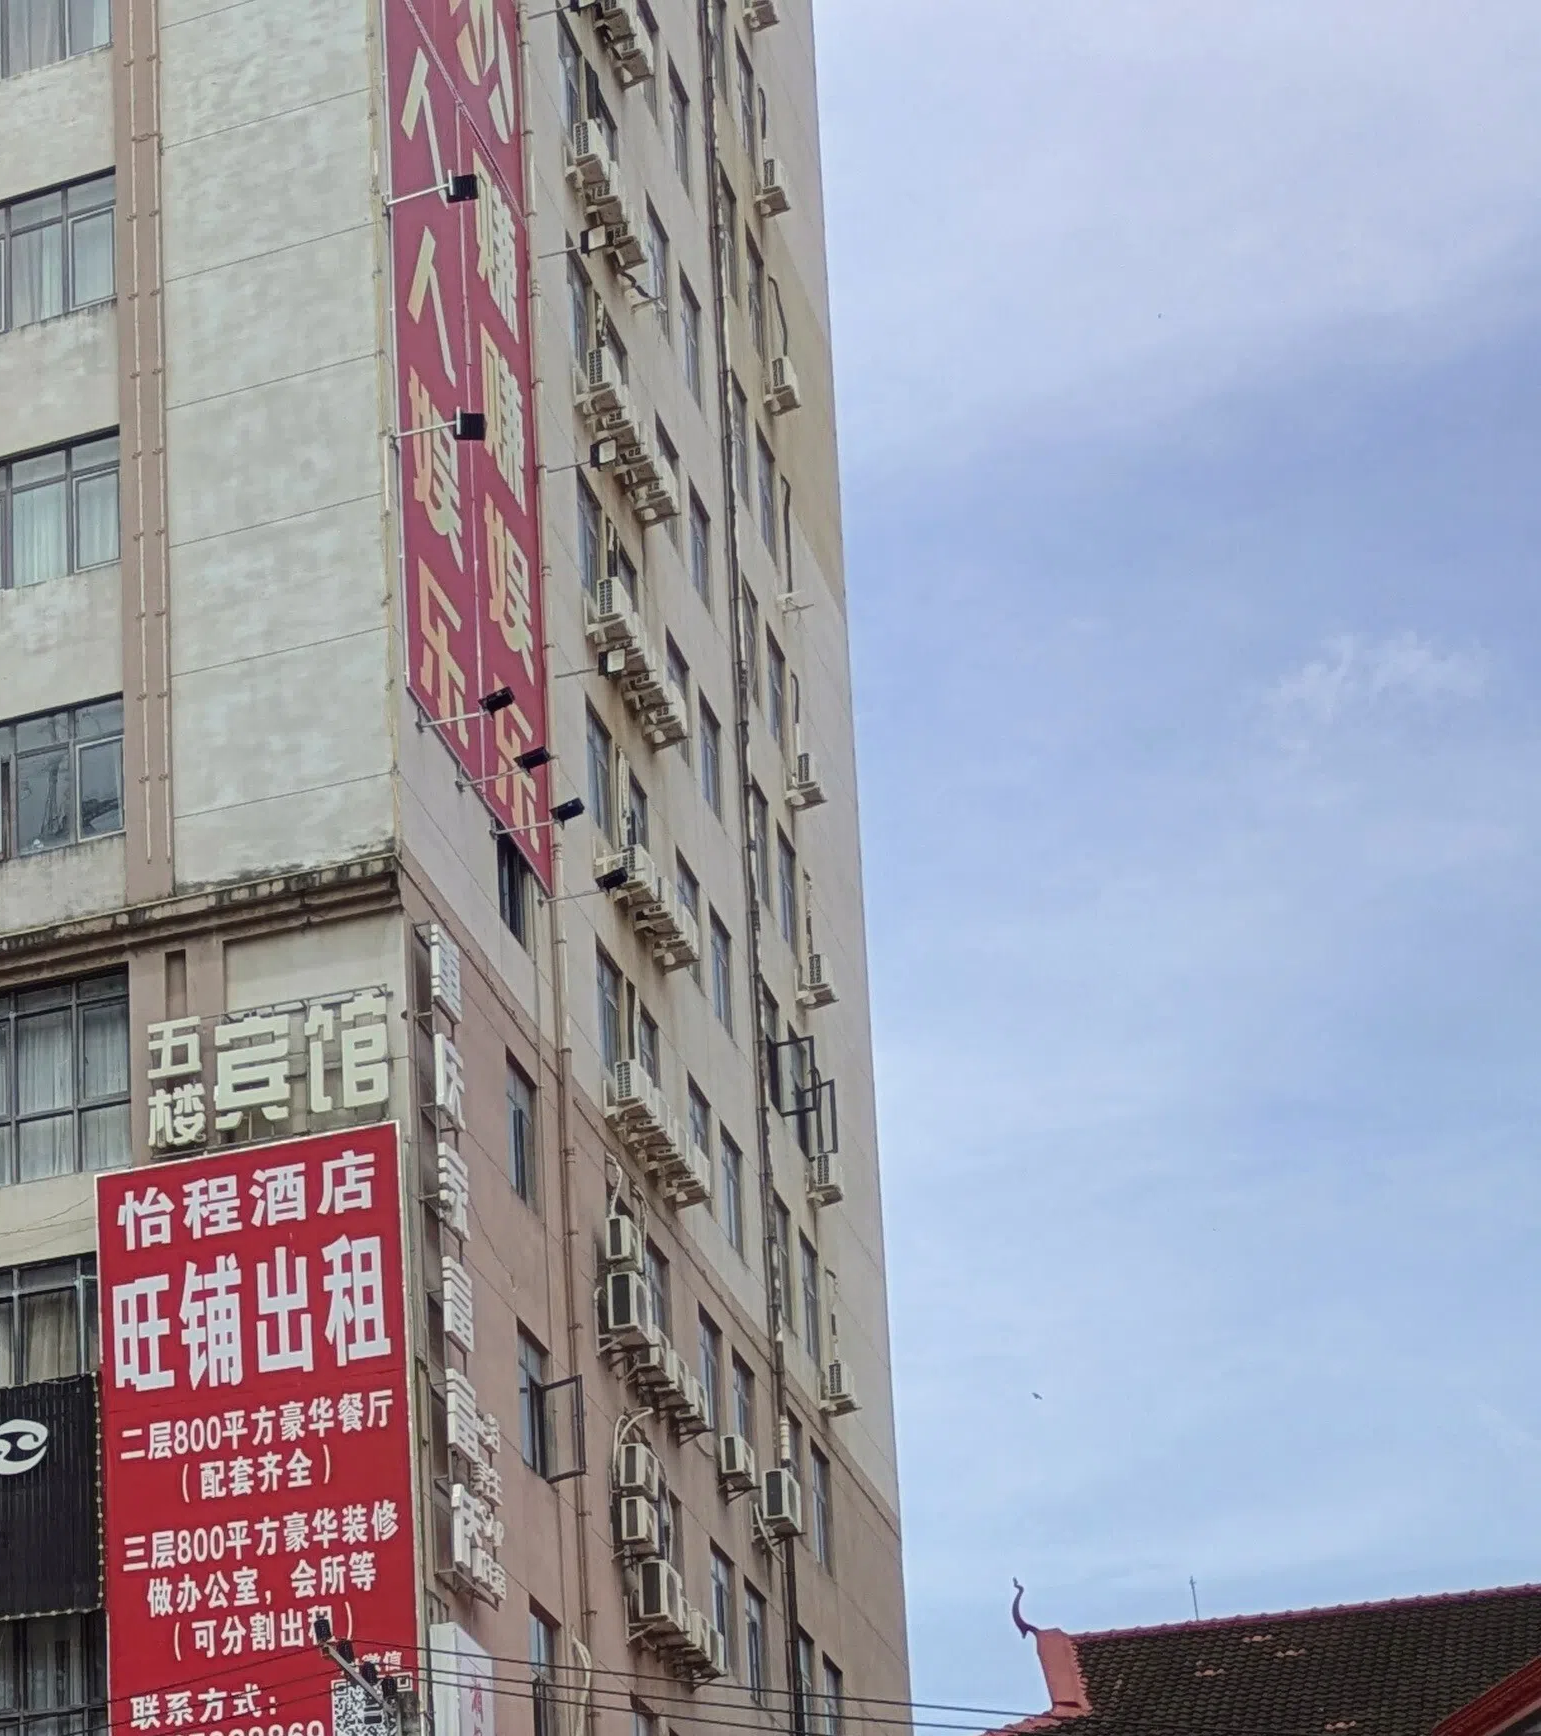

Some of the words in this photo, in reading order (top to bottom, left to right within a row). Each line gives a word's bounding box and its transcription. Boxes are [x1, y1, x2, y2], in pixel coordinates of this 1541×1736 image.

[147, 1016, 207, 1148] 五楼
[214, 990, 390, 1130] 宾馆
[117, 1149, 376, 1251] 怡程酒店
[111, 1233, 392, 1393] 旺铺出租
[119, 1388, 394, 1461] 二层800平方豪华餐厅
[122, 1499, 400, 1572] 三层800平方豪华装修
